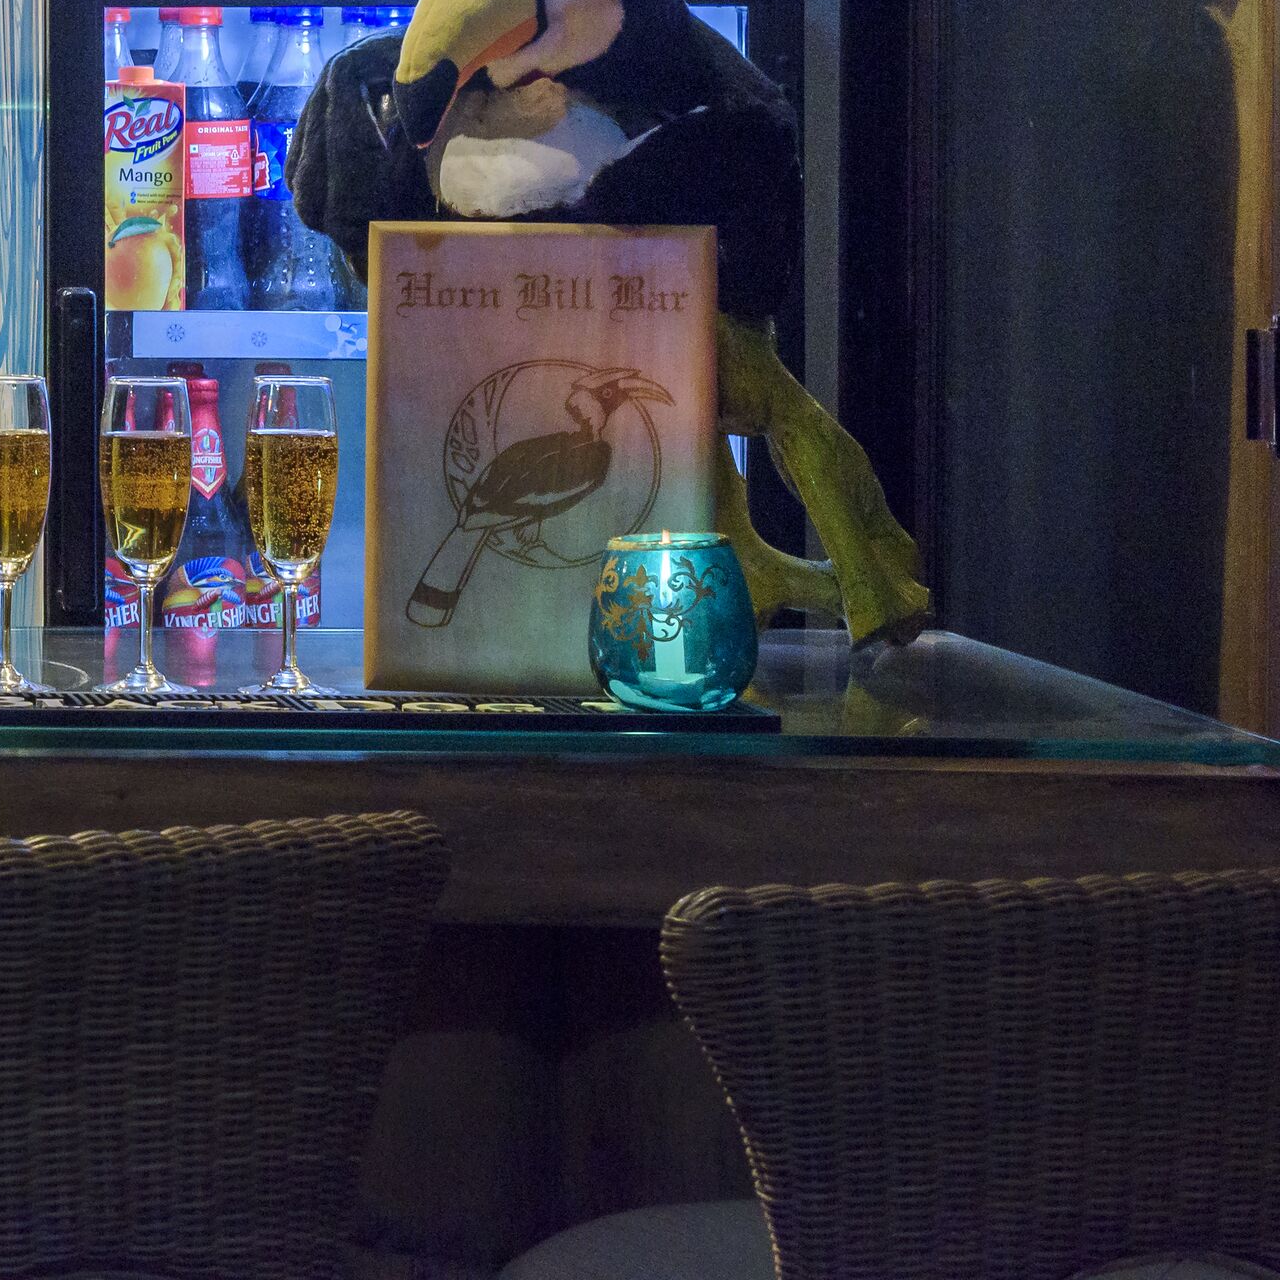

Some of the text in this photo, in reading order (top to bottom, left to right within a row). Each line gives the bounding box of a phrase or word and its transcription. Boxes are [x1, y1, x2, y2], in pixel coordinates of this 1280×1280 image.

[105, 99, 175, 152] Real
[198, 126, 234, 134] ORIGINAL
[135, 139, 161, 161] Fruit
[119, 168, 173, 186] Mango
[396, 272, 689, 322] Horn Bill Bar
[302, 699, 546, 713] DOG
